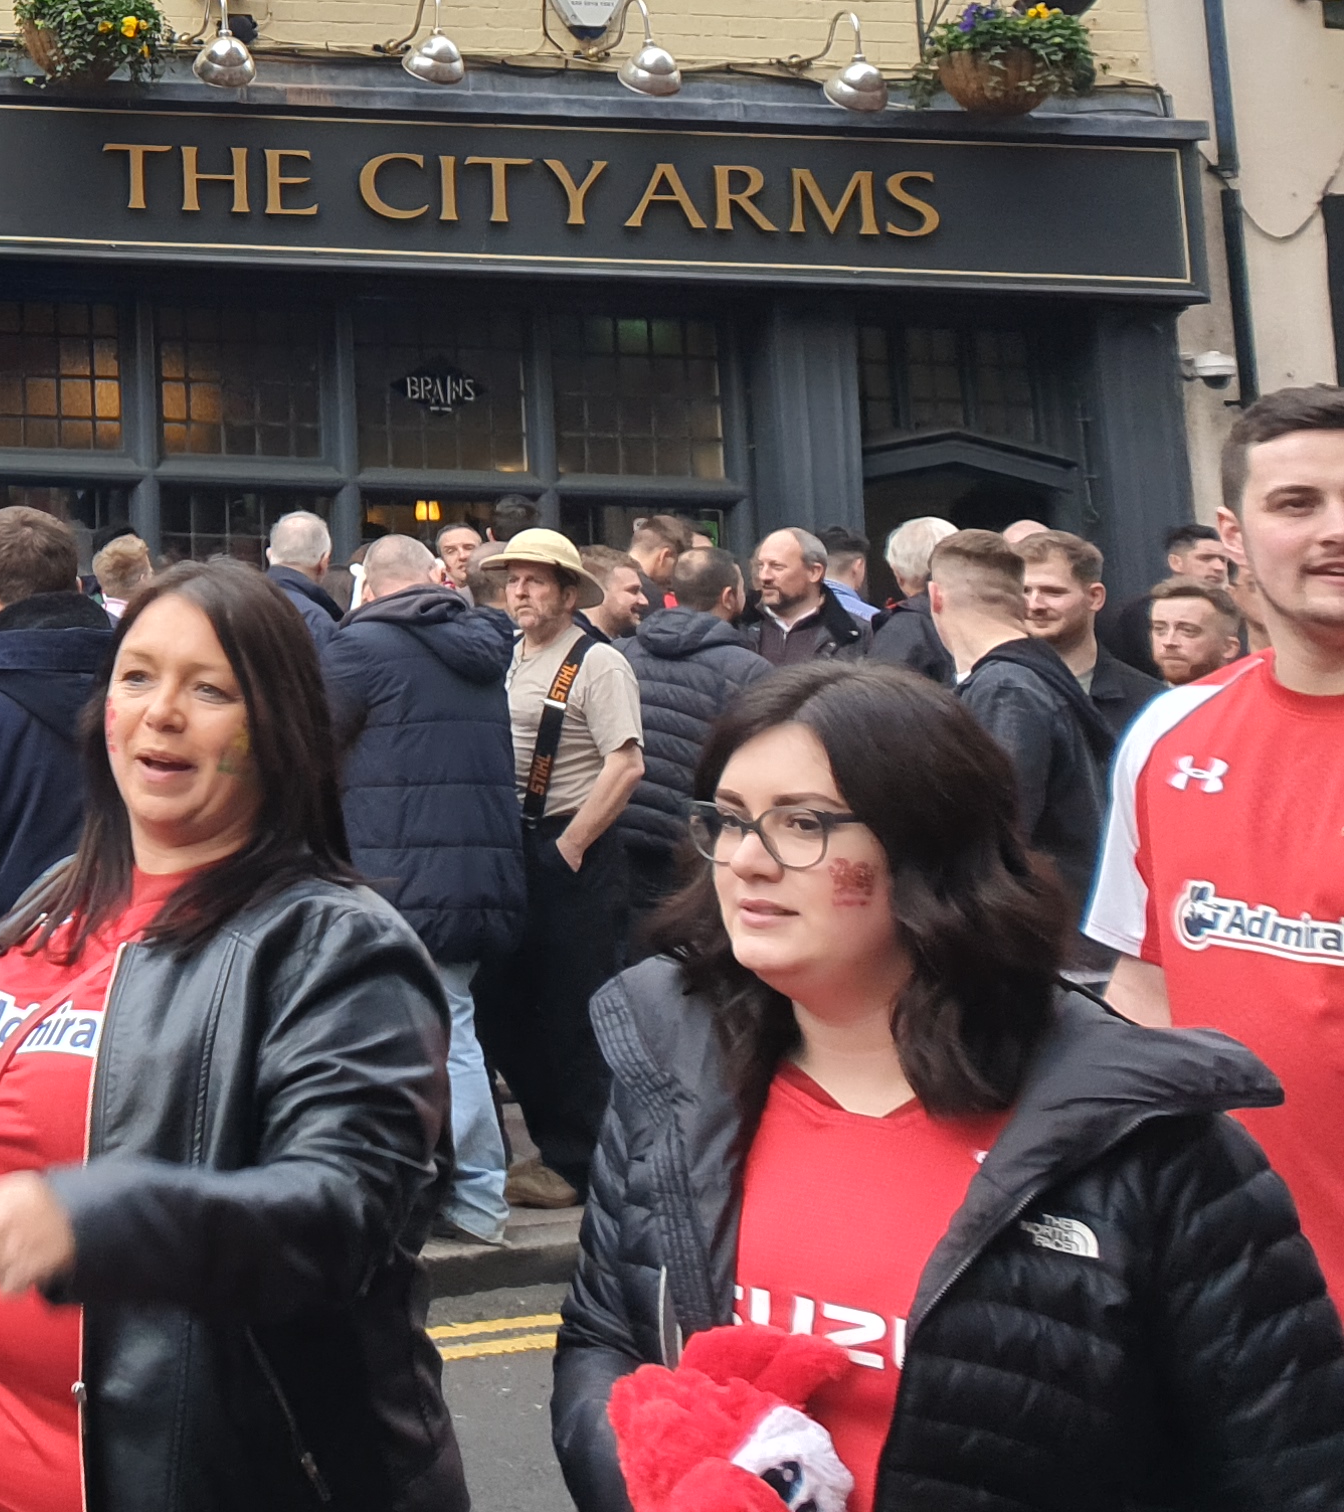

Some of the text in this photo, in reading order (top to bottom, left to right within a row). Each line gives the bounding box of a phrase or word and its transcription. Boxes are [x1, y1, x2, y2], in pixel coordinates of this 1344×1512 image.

[101, 142, 943, 238] THE CITY ARMS
[550, 663, 578, 702] STIHL
[530, 753, 551, 796] STIHL
[1226, 904, 1344, 952] Admira
[1021, 1221, 1073, 1241] NORTH
[1042, 1214, 1073, 1229] THE
[1033, 1235, 1073, 1252] FACE
